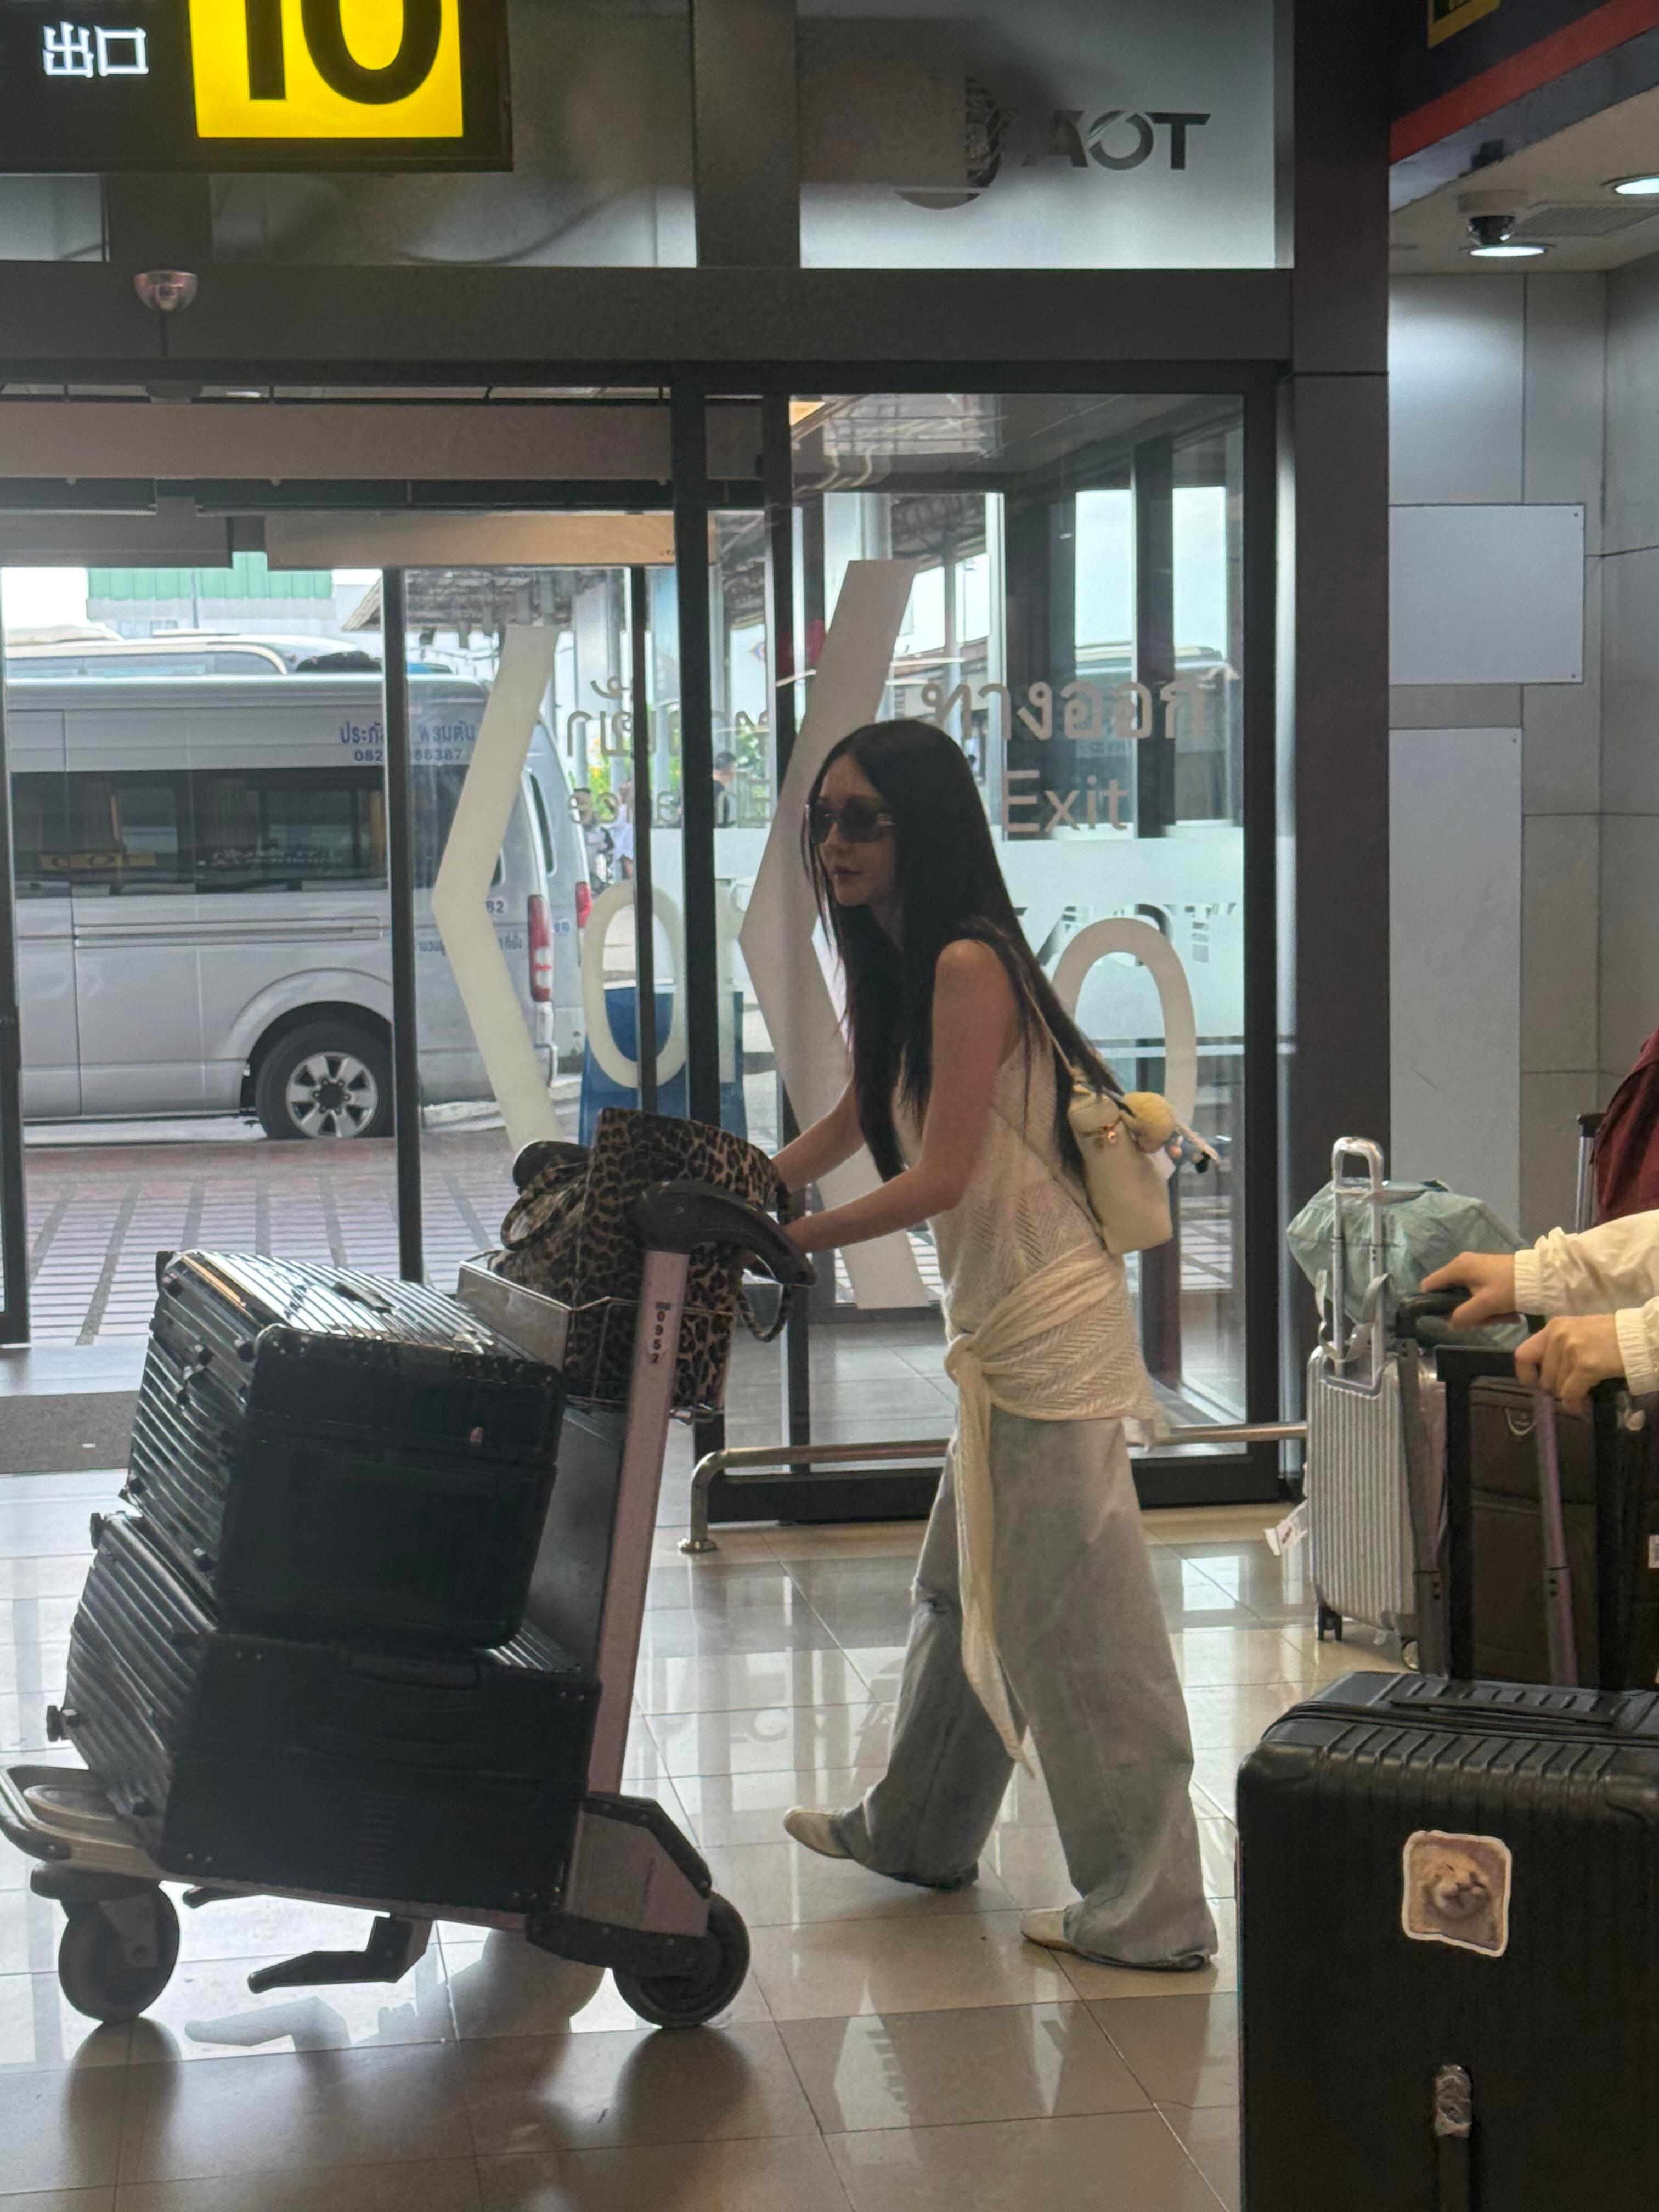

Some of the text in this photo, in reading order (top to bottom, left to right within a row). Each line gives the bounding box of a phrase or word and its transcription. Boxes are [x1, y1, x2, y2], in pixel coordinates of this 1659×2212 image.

[43, 21, 149, 77] 出口
[1021, 110, 1211, 171] AOT
[921, 681, 1207, 741] ทางออก
[1002, 770, 1128, 831] Exit
